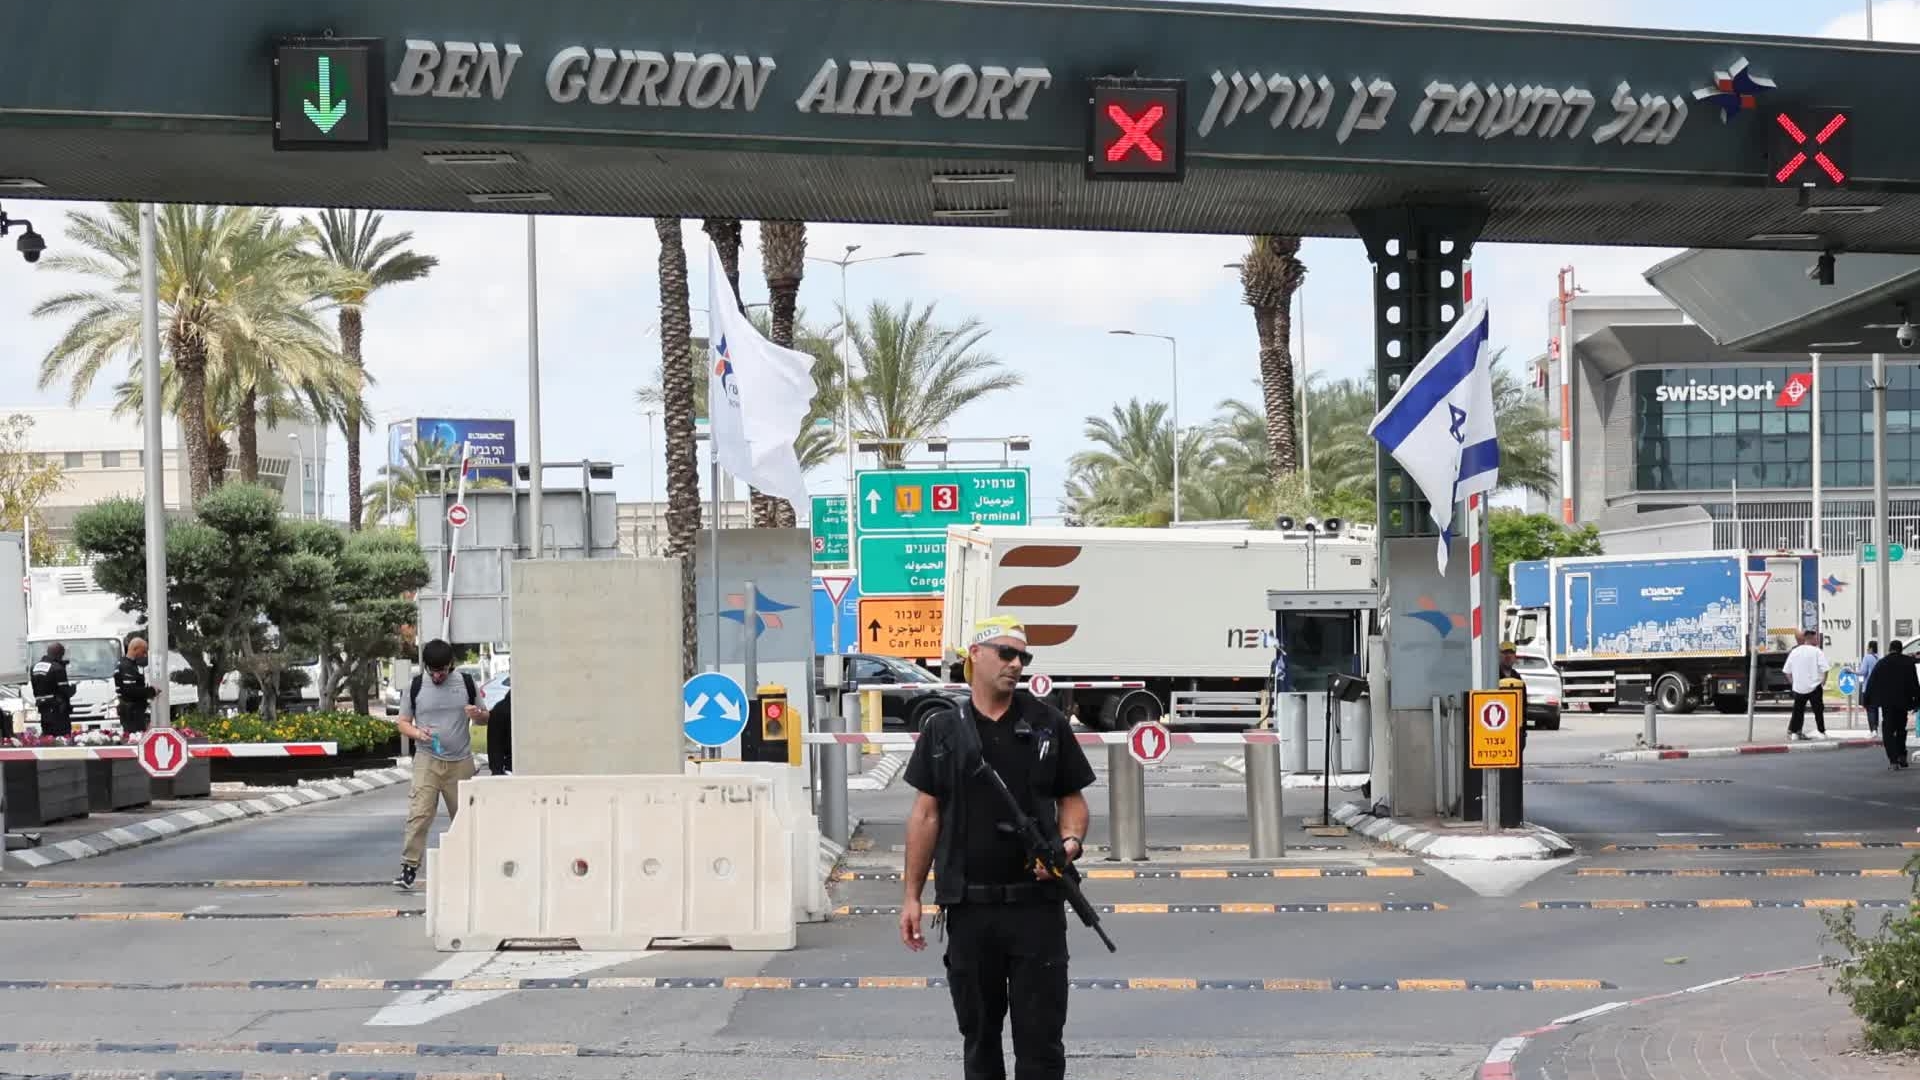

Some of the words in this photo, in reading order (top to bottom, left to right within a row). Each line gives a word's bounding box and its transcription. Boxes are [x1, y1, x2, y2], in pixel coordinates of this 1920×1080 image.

[390, 39, 523, 100] BEN
[545, 46, 776, 113] GURION
[795, 57, 1052, 121] AIRPORT
[1197, 69, 1336, 138] גוריון
[1409, 79, 1596, 140] התעופה
[1336, 76, 1397, 145] בן
[1592, 80, 1689, 145] נמל
[1655, 379, 1775, 407] swissport
[973, 477, 1016, 489] טרמינל
[904, 492, 912, 507] 1
[938, 488, 953, 509] 3
[969, 510, 1021, 521] Terminal
[815, 538, 824, 551] 3
[910, 576, 946, 588] Cargo
[895, 609, 922, 619] שכור
[929, 609, 943, 619] כב
[889, 638, 910, 649] Car
[914, 638, 942, 649] Rent
[1484, 737, 1506, 746] עצור
